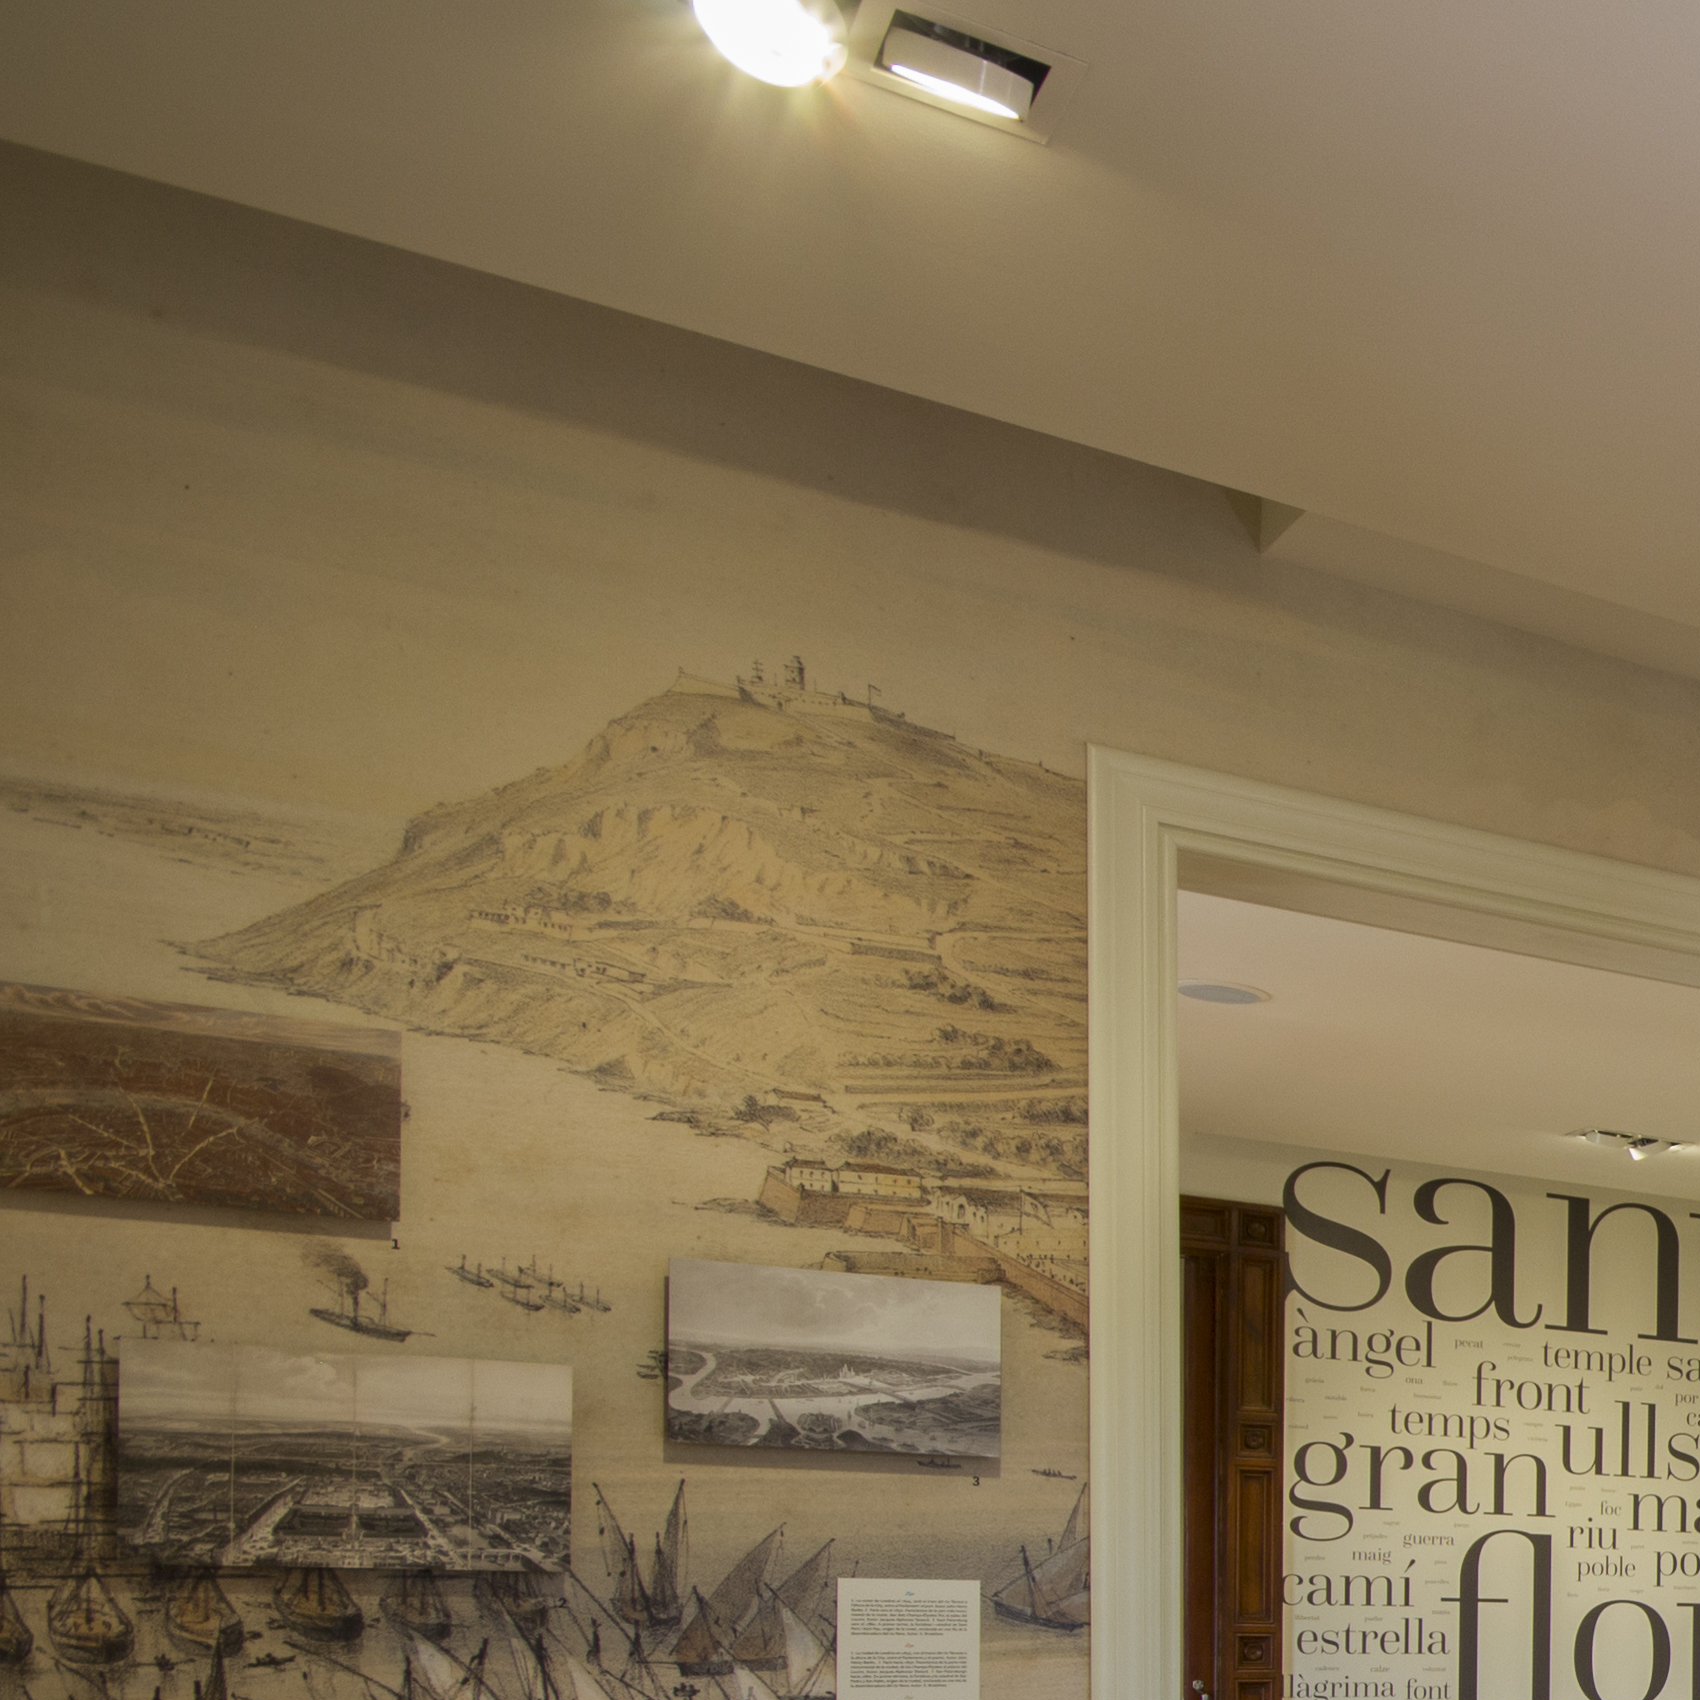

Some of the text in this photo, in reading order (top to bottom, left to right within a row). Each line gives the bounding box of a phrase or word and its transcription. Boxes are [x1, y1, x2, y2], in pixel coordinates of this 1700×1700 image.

[392, 1238, 400, 1250] 1
[1292, 1308, 1484, 1379] àngel pecat
[1541, 1340, 1652, 1382] temple
[1405, 1376, 1423, 1385] ona
[1472, 1360, 1591, 1414] front
[1675, 1392, 1699, 1406] por
[1388, 1403, 1510, 1450] temps
[1554, 1400, 1700, 1481] ulls
[972, 1475, 980, 1486] 3
[1289, 1432, 1556, 1541] gran
[1600, 1500, 1622, 1516] foc
[1403, 1532, 1455, 1548] guerra
[1566, 1517, 1619, 1550] riu
[1351, 1548, 1392, 1565] maig
[1577, 1555, 1636, 1582] poble
[1281, 1559, 1416, 1607] camí
[1297, 1617, 1450, 1655] estrella
[1405, 1678, 1451, 1700] font
